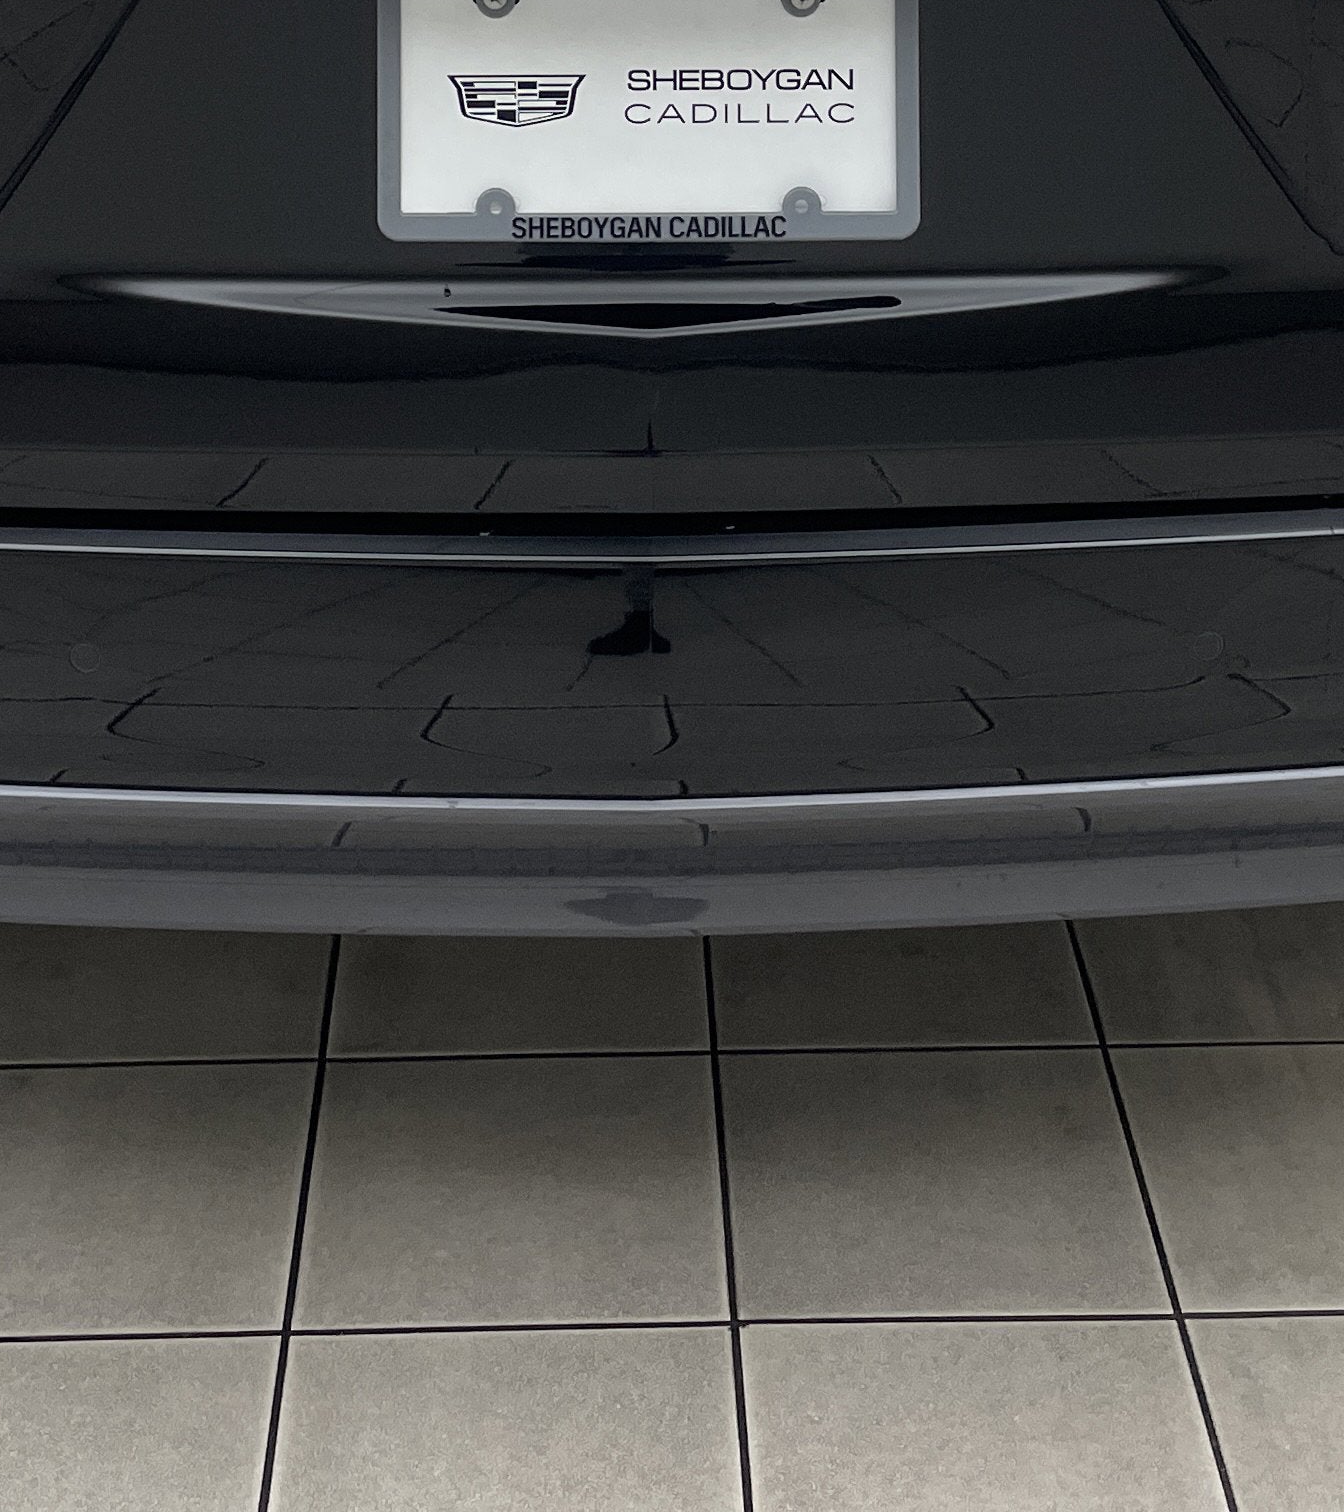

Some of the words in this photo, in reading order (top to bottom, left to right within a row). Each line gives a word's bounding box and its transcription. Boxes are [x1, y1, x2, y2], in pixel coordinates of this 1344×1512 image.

[627, 69, 854, 91] SHEBOYGAN
[624, 102, 855, 124] CADILLAC
[511, 216, 662, 240] SHEBOYGAN
[669, 215, 787, 238] CADILLAC
